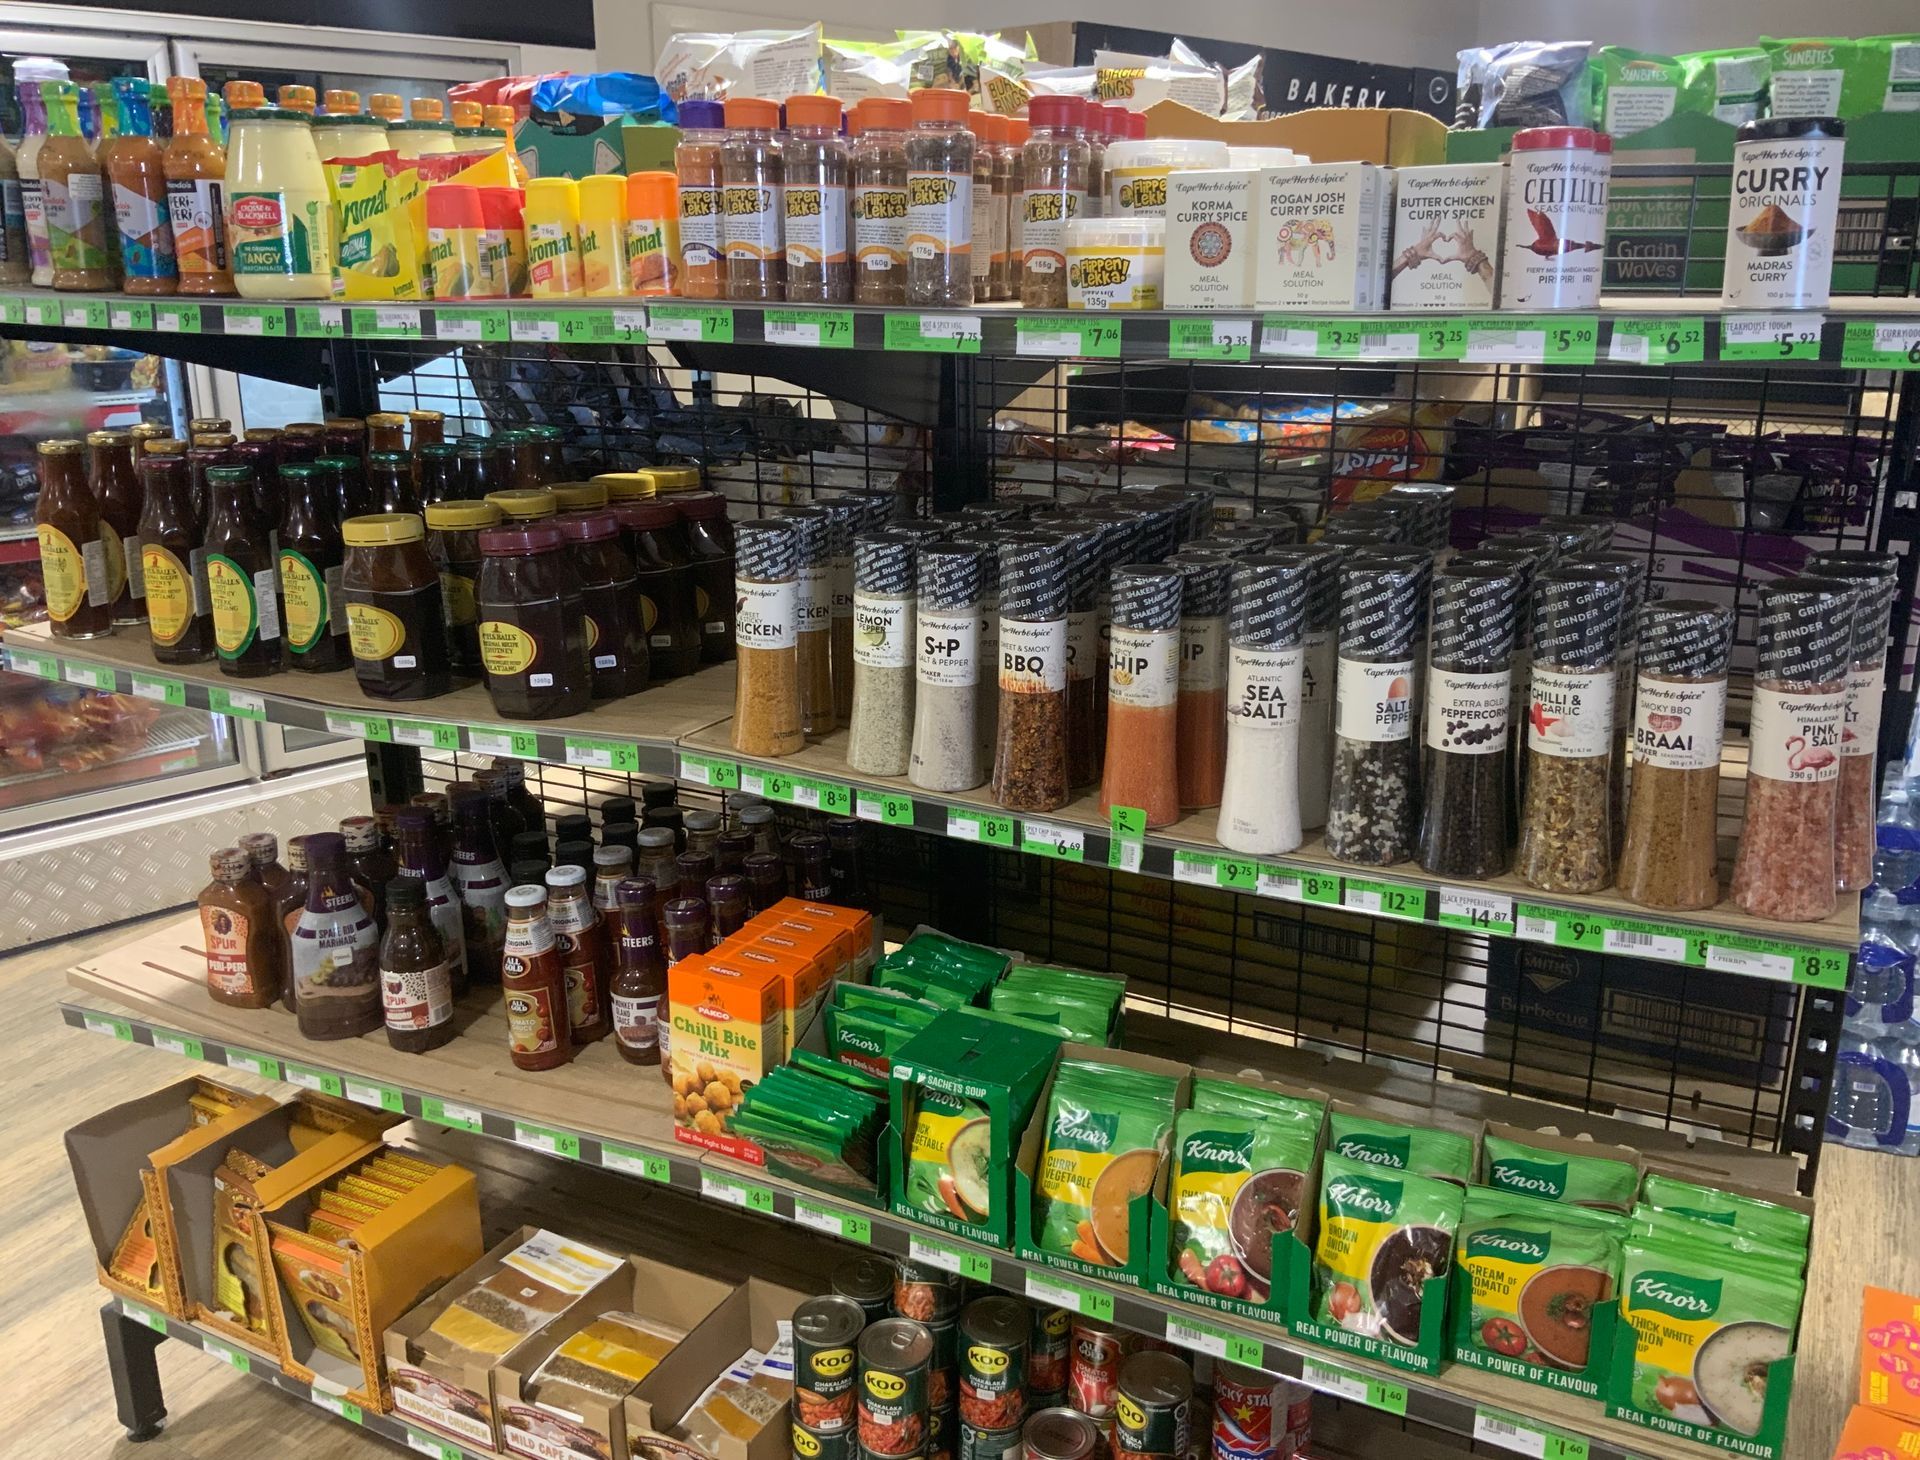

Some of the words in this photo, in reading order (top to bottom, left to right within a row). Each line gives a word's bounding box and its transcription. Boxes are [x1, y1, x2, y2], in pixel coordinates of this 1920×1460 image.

[1783, 54, 1835, 73] SUNBITES
[1619, 73, 1669, 89] SUNBITES
[1287, 78, 1386, 109] BAKERY
[1735, 166, 1830, 194] CURRY
[1191, 200, 1233, 212] KORMA
[1270, 194, 1313, 205] ROGAN
[1315, 191, 1346, 203] JOSH
[1400, 197, 1442, 208] BUTTER
[1443, 195, 1495, 207] CHICKEN
[1739, 194, 1817, 209] ORIGINALS
[1176, 212, 1215, 223] CURRY
[1216, 211, 1248, 222] SPICE
[1270, 206, 1311, 217] CURRY
[1312, 204, 1345, 215] SPICE
[1408, 209, 1448, 221] CURRY
[1451, 208, 1486, 220] SPICE
[242, 252, 281, 265] TANGY
[1616, 239, 1678, 259] Grain
[1292, 270, 1315, 279] MEAL
[1747, 260, 1793, 271] MADRAS
[1282, 279, 1324, 288] SOLUTION
[1420, 281, 1463, 290] SOLUTION
[1430, 273, 1453, 281] MEAL
[1750, 271, 1788, 282] CURRY
[1190, 284, 1229, 292] SOLUTION
[1086, 297, 1107, 309] 135g
[705, 316, 729, 334] $7.75
[824, 319, 849, 339] $7.75
[951, 330, 978, 349] $7.75
[1088, 327, 1119, 347] $7.06
[1218, 334, 1248, 355] $3.35
[1327, 330, 1359, 352] $3.25
[1429, 330, 1463, 352] $3.25
[1552, 329, 1592, 352] $5.90
[1659, 330, 1700, 354] $6.52
[1774, 331, 1816, 356] $5.92
[1006, 550, 1041, 566] GRINDER
[1010, 578, 1048, 596] GRINDER
[1125, 584, 1156, 599] SHAKER
[1241, 575, 1278, 595] GRINDER
[855, 612, 893, 627] LEMON
[1248, 605, 1288, 626] GRINDER
[1347, 610, 1385, 631] GRINDER
[1553, 607, 1600, 628] GRINDER
[924, 636, 961, 658] S+P
[1023, 644, 1051, 654] SMOKY
[939, 657, 969, 668] PEPPER
[1003, 653, 1044, 678] BBQ
[1781, 653, 1834, 677] GRINDER
[1246, 674, 1283, 683] ATLANTIC
[1246, 684, 1285, 702] SEA
[1532, 689, 1568, 706] CHILLI
[1570, 693, 1582, 707] &
[1241, 702, 1288, 720] SALT
[1376, 700, 1407, 715] SALT
[1452, 698, 1482, 709] EXTRA
[1483, 697, 1504, 707] BOLD
[1540, 704, 1581, 716] GARLIC
[1640, 700, 1668, 713] SMOKY
[1669, 703, 1692, 715] BBQ
[1637, 726, 1693, 752] BRAAI
[1801, 723, 1837, 738] PINK
[1811, 733, 1840, 748] SALT
[1788, 770, 1805, 781] 390
[1223, 863, 1252, 881] $9.75
[1302, 876, 1334, 896] $8.92
[1383, 890, 1420, 911] $12.21
[1465, 907, 1508, 929] $14.87
[1567, 921, 1602, 941] $9.10
[210, 938, 237, 950] SPUR
[622, 935, 655, 948] STEERS
[1801, 955, 1840, 977] $8.95
[698, 1005, 730, 1022] PAKCO
[673, 1015, 722, 1040] Chilli
[723, 1028, 758, 1051] Bite
[840, 1029, 882, 1054] Knorr
[697, 1036, 731, 1060] Mix
[928, 1074, 963, 1095] SACHETS
[964, 1085, 987, 1099] SOUP
[1054, 1118, 1111, 1147] Knorr
[1186, 1139, 1248, 1166] Knorr
[1339, 1142, 1404, 1168] Knorr
[1046, 1155, 1077, 1172] CURRY
[1044, 1167, 1093, 1189] VEGETABLE
[1494, 1165, 1560, 1196] Knorr
[1327, 1183, 1395, 1216] Knorr
[896, 1202, 915, 1219] REAL
[918, 1209, 946, 1228] POWER
[949, 1219, 960, 1233] OF
[961, 1224, 1000, 1246] FLAVOUR
[1328, 1222, 1359, 1243] BROWN
[1326, 1237, 1350, 1255] ONION
[1472, 1233, 1544, 1258] Knorr
[1021, 1248, 1044, 1263] REAL
[1047, 1254, 1080, 1274] POWER
[1082, 1261, 1094, 1275] OF
[1097, 1267, 1140, 1287] FLAVOUR
[1468, 1263, 1505, 1281] CREAM
[1507, 1276, 1519, 1286] OF
[1156, 1283, 1180, 1299] REAL
[1183, 1290, 1218, 1308] POWER
[1220, 1298, 1233, 1311] OF
[1236, 1303, 1281, 1323] FLAVOUR
[1635, 1277, 1713, 1314] Knorr
[1630, 1314, 1661, 1335] THICK
[1662, 1326, 1695, 1347] WHITE
[1296, 1320, 1320, 1338] REAL
[1324, 1328, 1361, 1349] POWER
[1364, 1338, 1378, 1353] OF
[1381, 1342, 1429, 1370] FLAVOUR
[815, 1353, 853, 1367] KOO
[970, 1351, 1008, 1367] KOO
[1456, 1347, 1483, 1367] REAL
[1486, 1356, 1525, 1378] POWER
[1529, 1368, 1544, 1382] OF
[1547, 1372, 1599, 1396] FLAVOUR
[867, 1374, 904, 1391] KOO
[509, 1432, 535, 1450] MILD
[1617, 1405, 1646, 1425] REAL
[1650, 1415, 1693, 1438] POWER
[1696, 1428, 1713, 1442] OF
[1716, 1434, 1773, 1460] FLAVOUR
